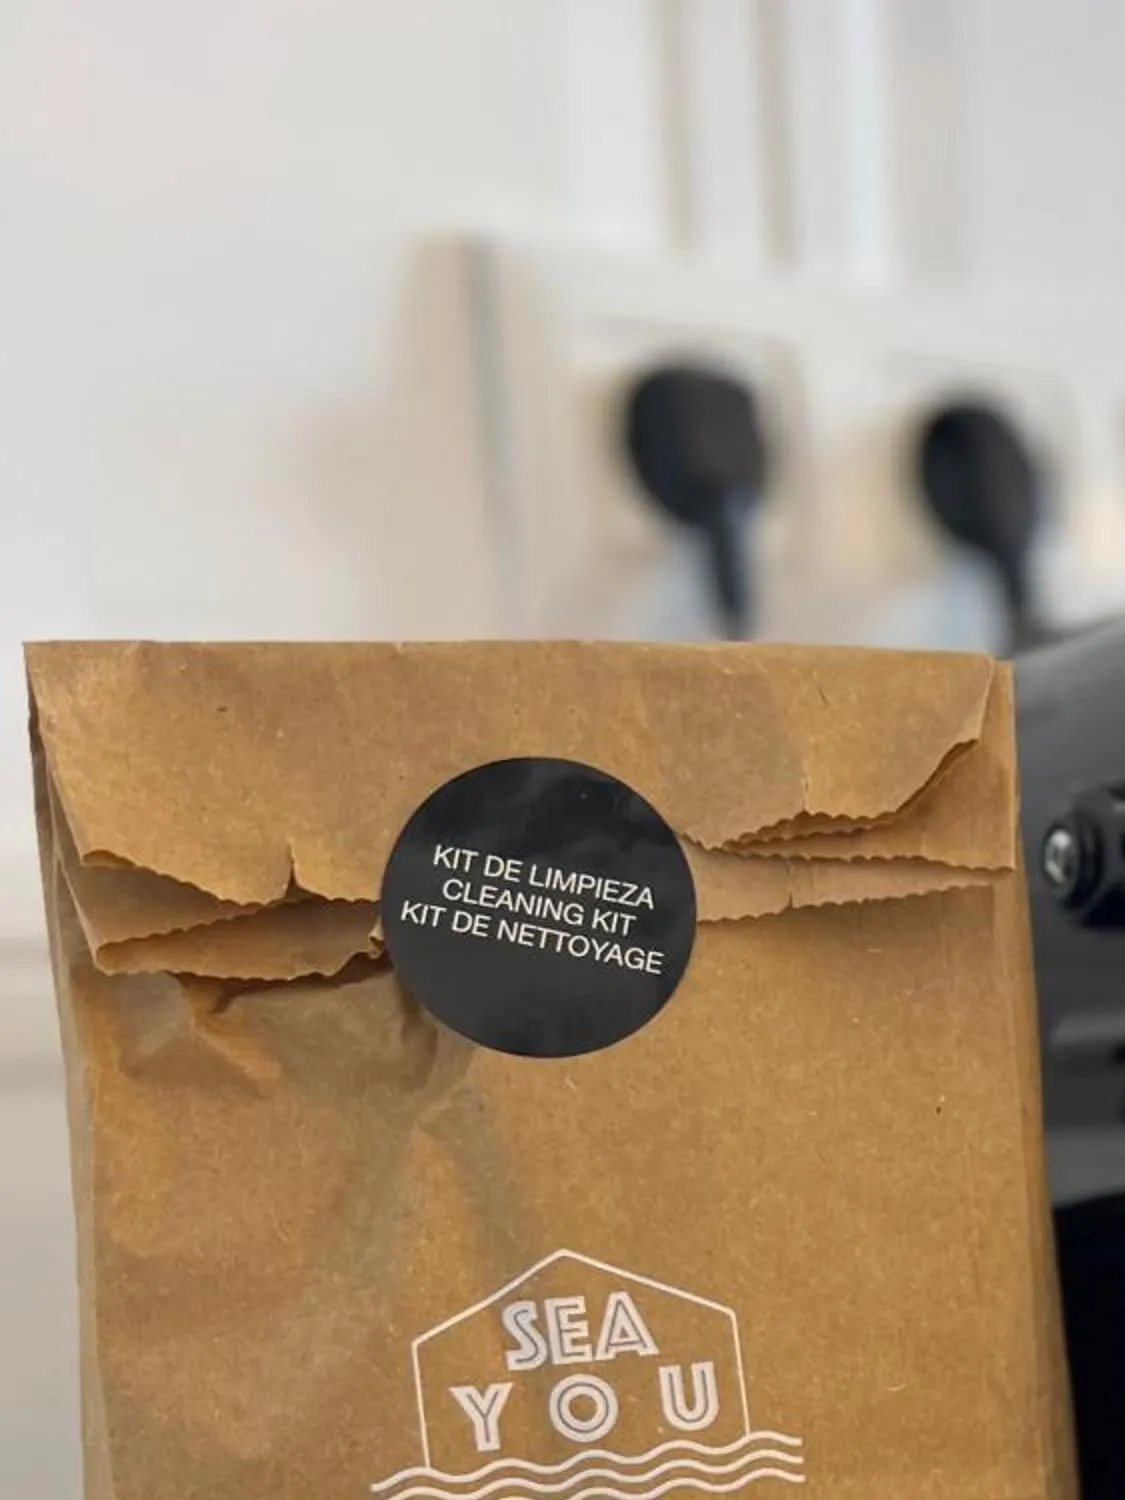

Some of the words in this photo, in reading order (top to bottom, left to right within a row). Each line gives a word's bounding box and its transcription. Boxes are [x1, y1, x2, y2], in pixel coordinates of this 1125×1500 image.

[433, 844, 479, 872] KIT
[484, 855, 524, 882] DE
[529, 864, 655, 910] LIMPIEZA
[442, 878, 586, 926] CLEANING
[592, 909, 637, 937] KIT
[401, 900, 447, 928] KIT
[452, 911, 492, 937] DE
[497, 919, 665, 975] NETTOYAGE
[502, 1291, 659, 1371] SEA
[449, 1361, 720, 1452] YOU
